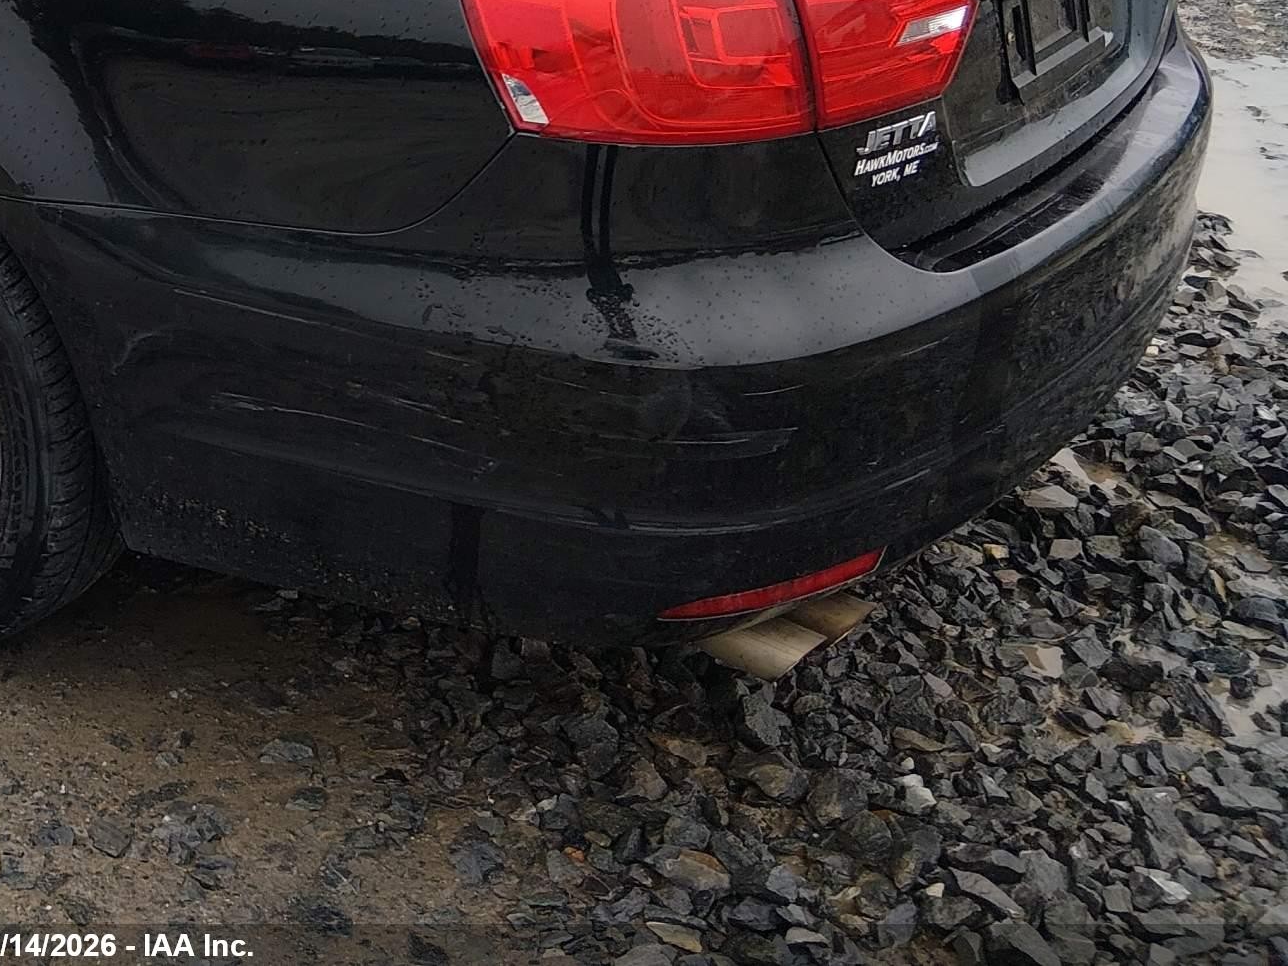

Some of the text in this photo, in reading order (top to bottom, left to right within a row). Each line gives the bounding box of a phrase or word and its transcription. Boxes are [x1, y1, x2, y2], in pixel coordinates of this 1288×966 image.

[856, 111, 936, 155] JETTA
[871, 159, 921, 187] YORK, ME
